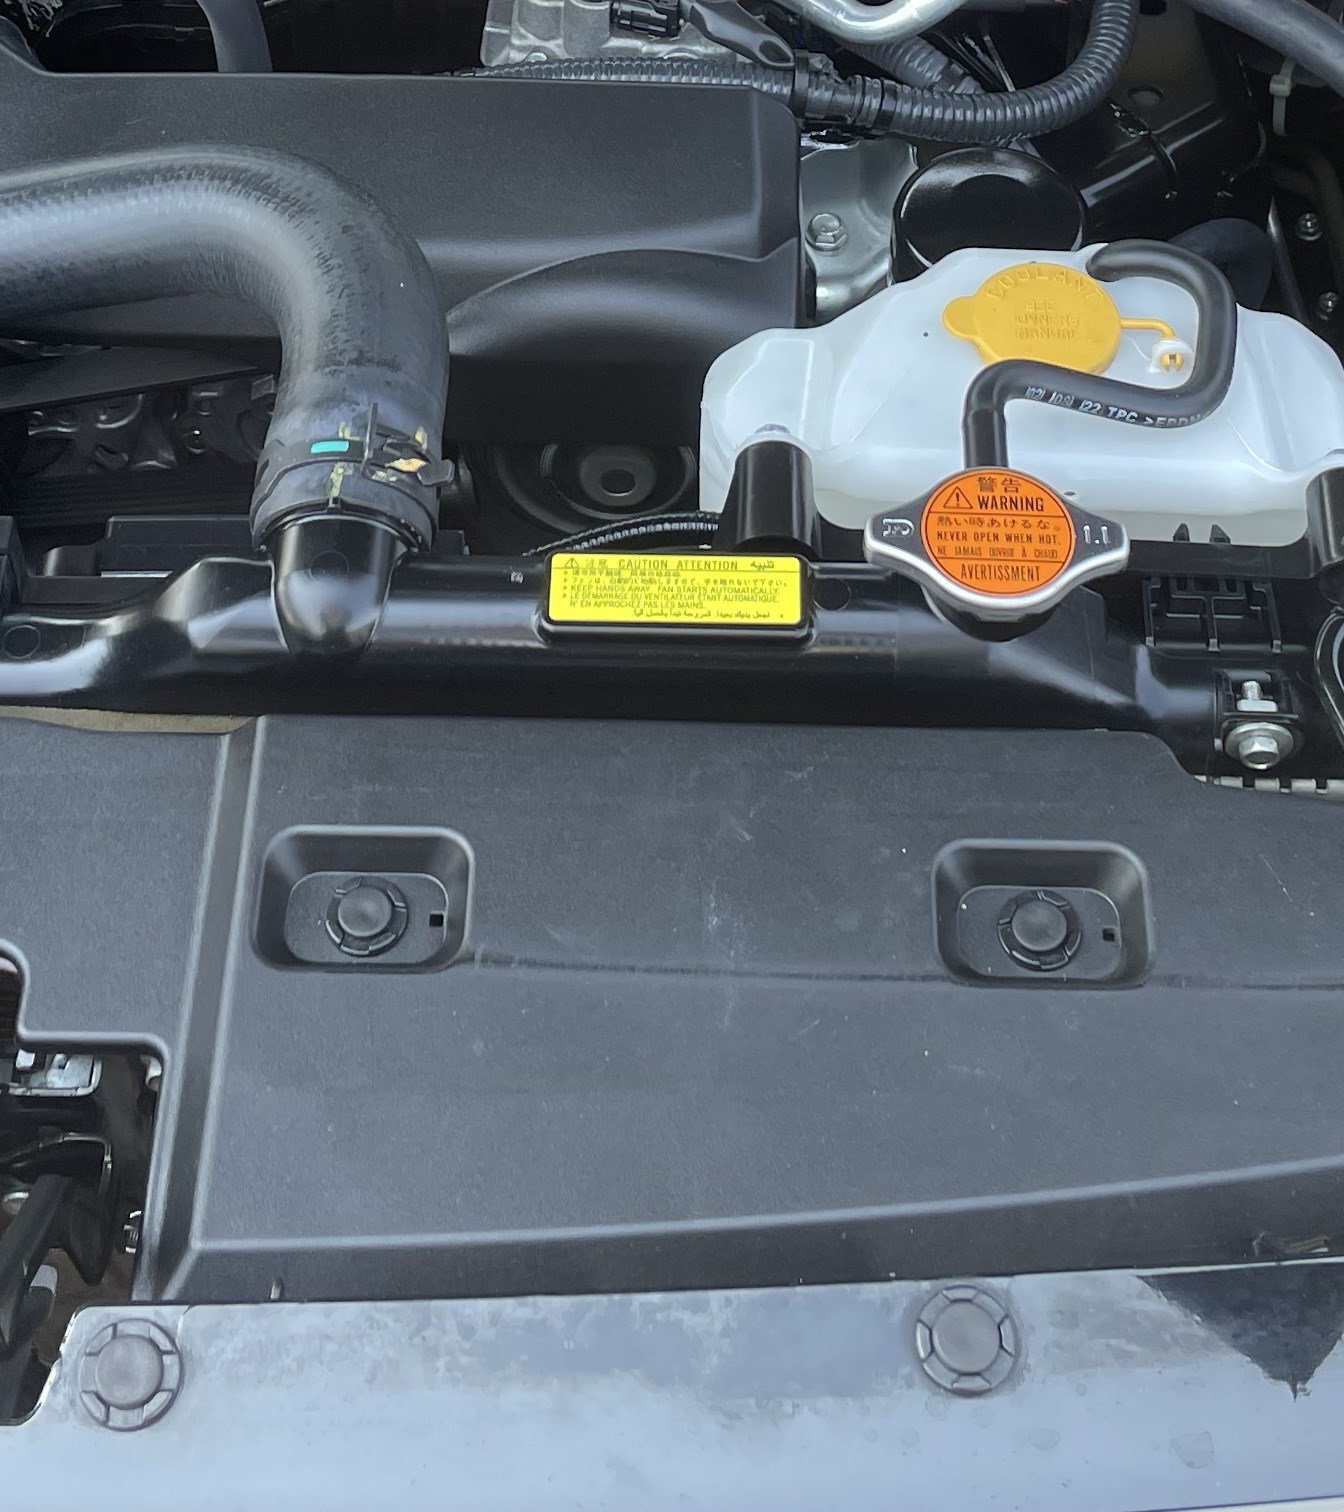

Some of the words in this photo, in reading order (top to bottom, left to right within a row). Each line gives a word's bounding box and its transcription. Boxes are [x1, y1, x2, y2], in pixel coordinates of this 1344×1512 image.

[986, 267, 1104, 304] COOLANT
[1107, 405, 1138, 423] TPC
[977, 476, 1021, 493] 警告
[977, 495, 1044, 512] WARNING
[937, 531, 967, 542] NEVER
[973, 531, 998, 542] OPEN
[1005, 533, 1032, 544] WHEN
[1083, 525, 1111, 544] 1.1
[937, 546, 946, 555] NE
[955, 546, 982, 556] JAMAIS
[618, 559, 668, 569] CAUTION
[676, 560, 738, 570] ATTENTION
[961, 564, 1041, 582] AVERTISSMENT
